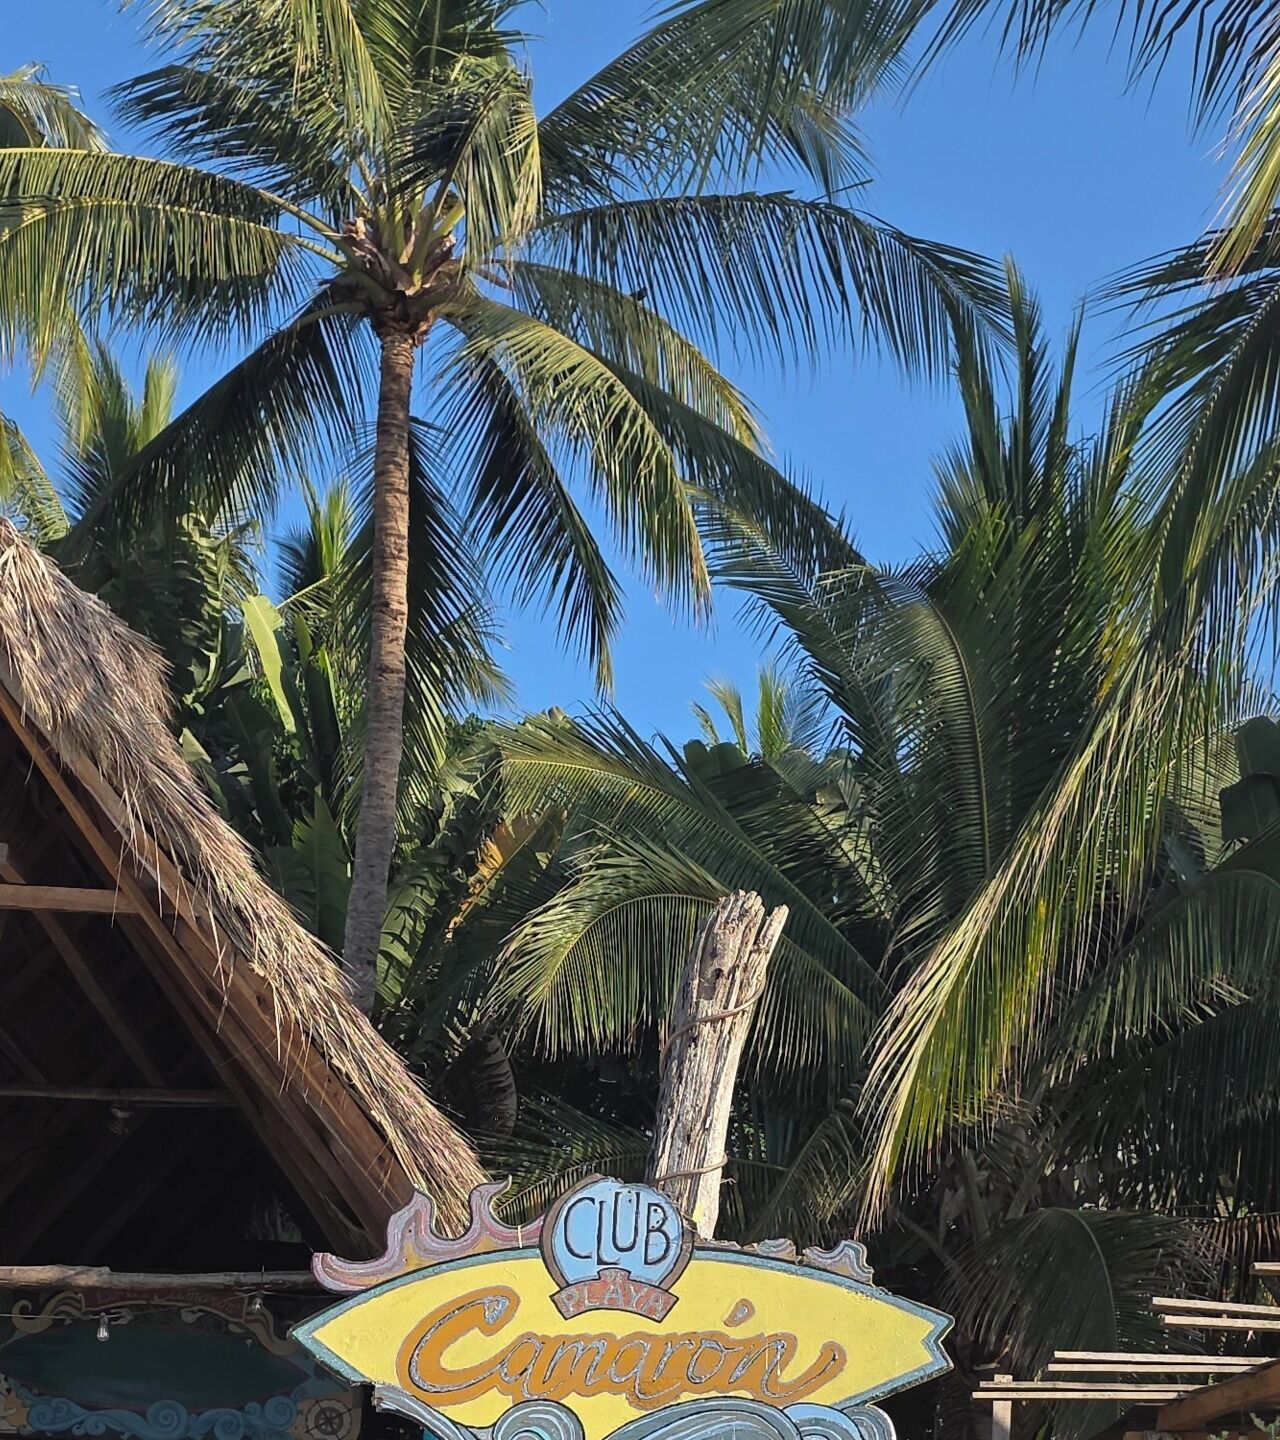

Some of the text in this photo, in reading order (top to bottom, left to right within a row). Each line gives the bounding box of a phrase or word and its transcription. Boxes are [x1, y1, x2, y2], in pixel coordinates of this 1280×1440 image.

[564, 1190, 671, 1266] CLUB
[561, 1281, 665, 1319] PLAYA
[404, 1291, 842, 1406] Camarón
